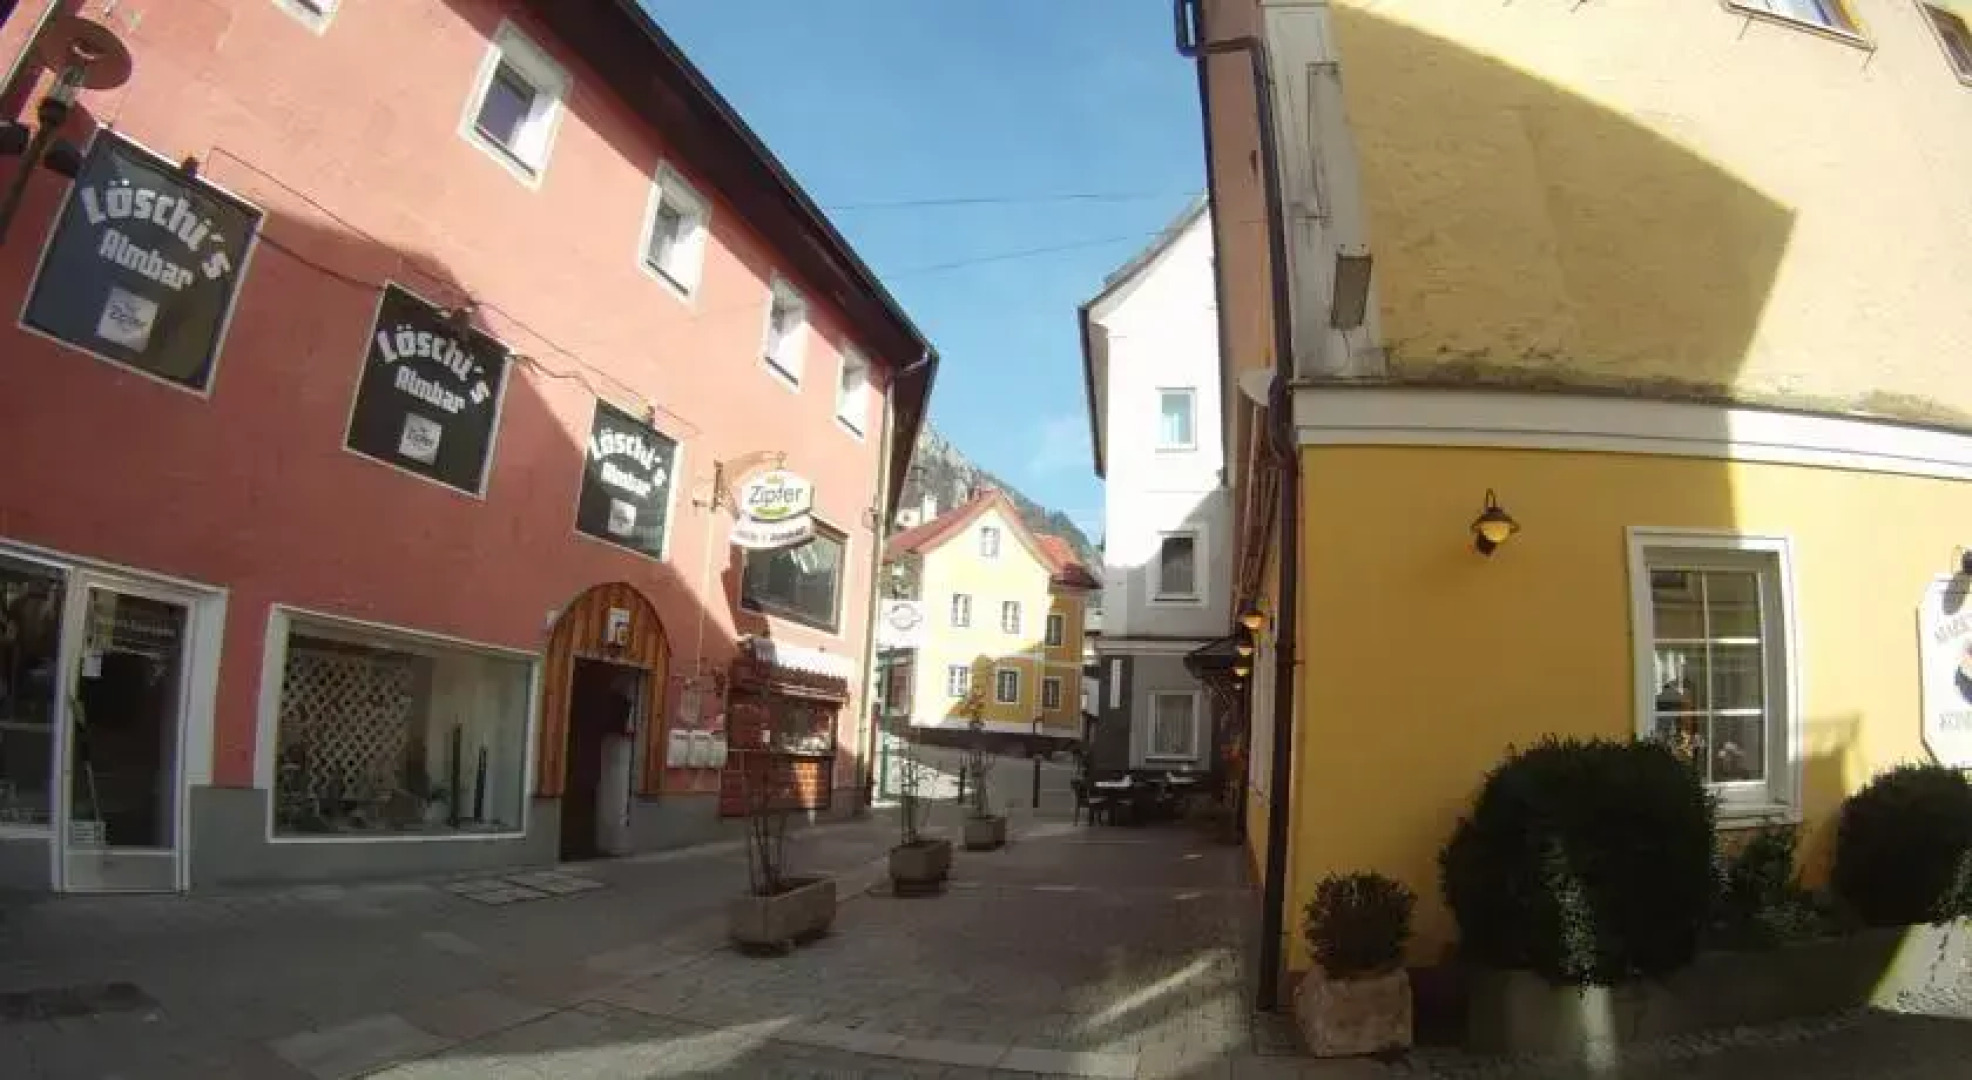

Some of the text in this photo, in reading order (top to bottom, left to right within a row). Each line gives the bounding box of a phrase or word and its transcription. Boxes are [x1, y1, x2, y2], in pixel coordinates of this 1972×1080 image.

[100, 227, 194, 291] Almbar
[394, 365, 466, 414] Almbar
[748, 481, 803, 507] Zipfer
